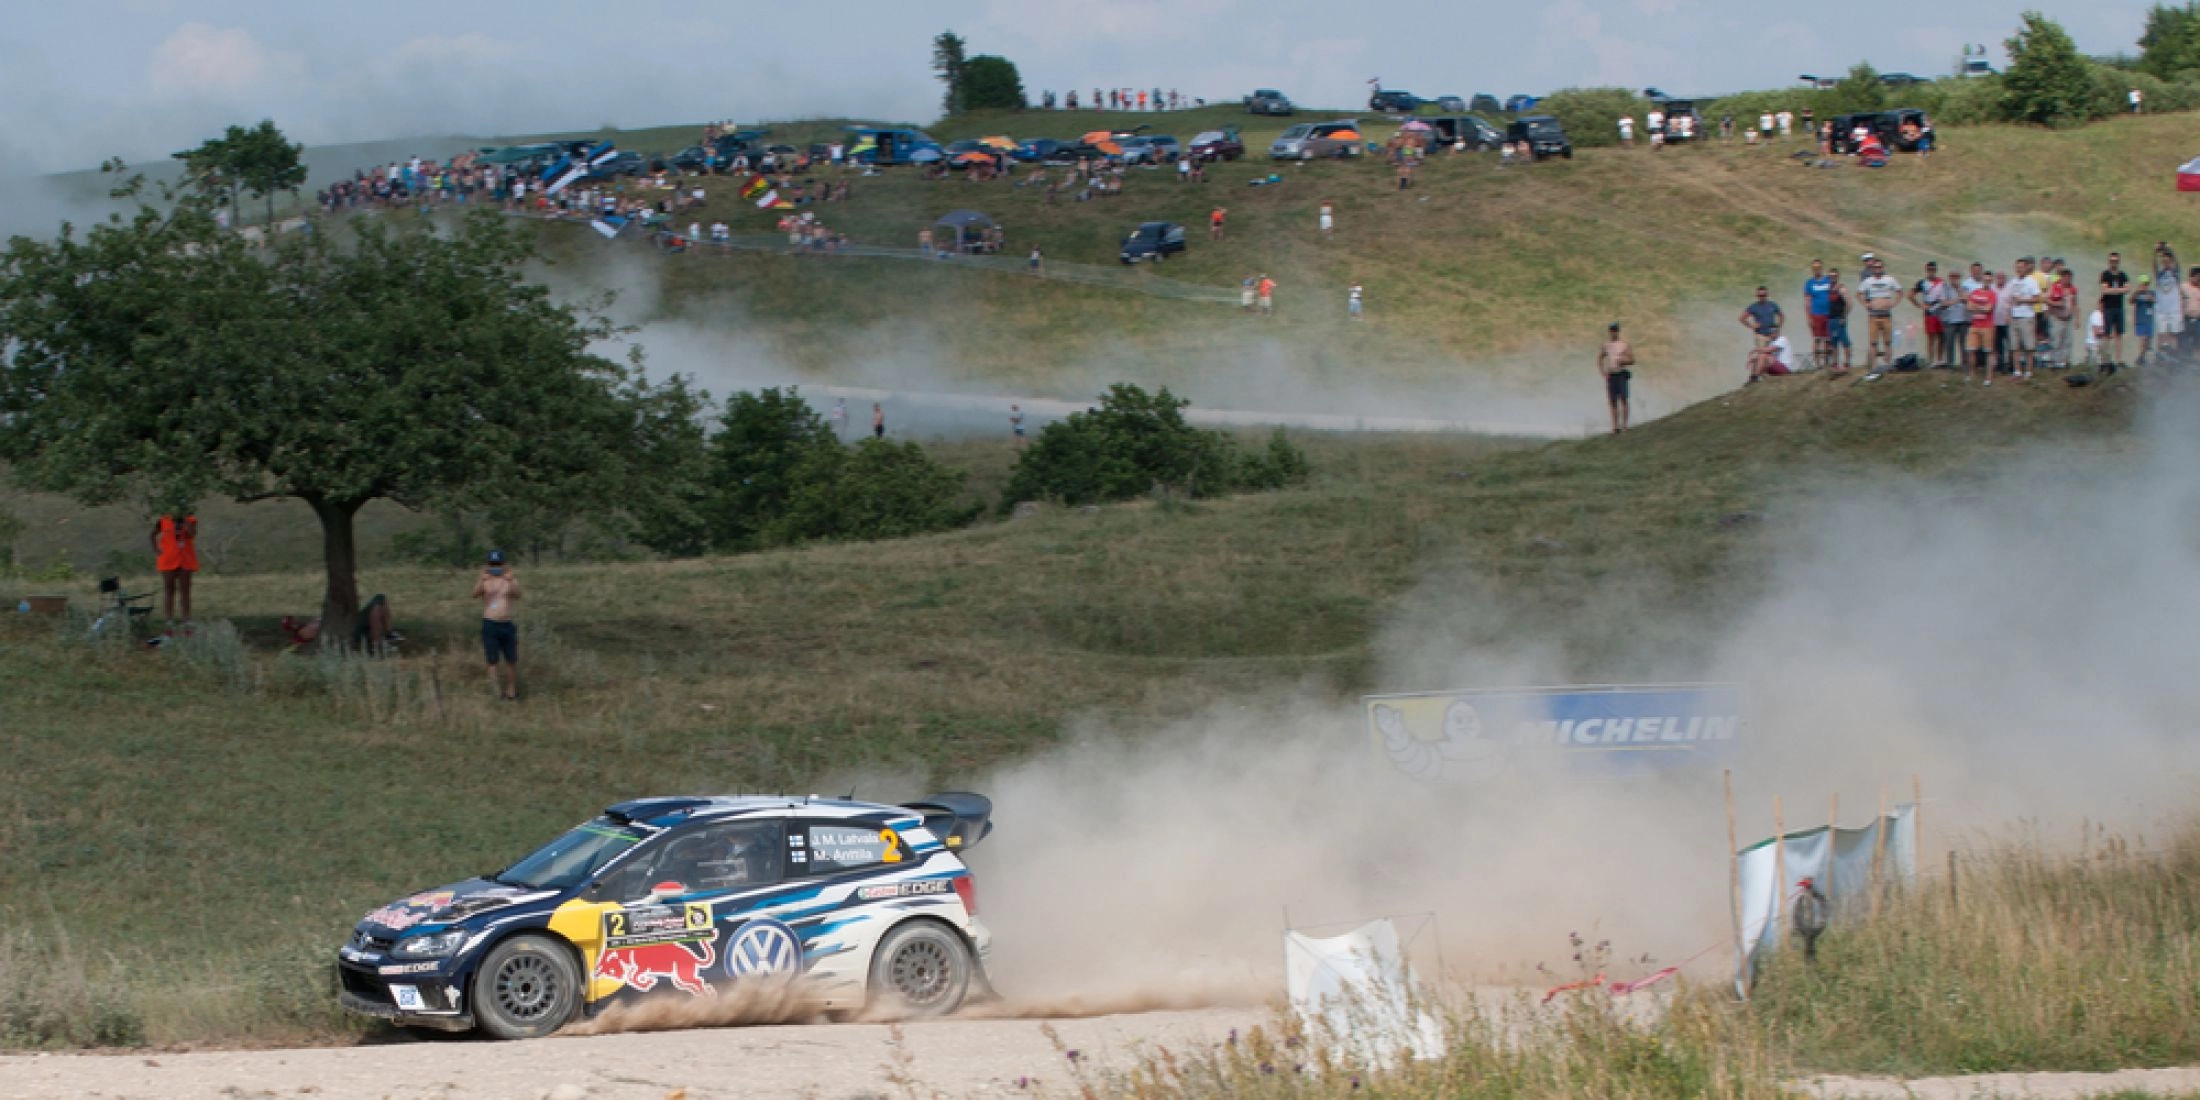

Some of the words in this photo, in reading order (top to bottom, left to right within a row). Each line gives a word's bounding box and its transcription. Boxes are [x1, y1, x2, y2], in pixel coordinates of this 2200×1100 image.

[1515, 715, 1738, 745] MICHELIN
[880, 827, 902, 862] 2
[611, 914, 626, 936] 2
